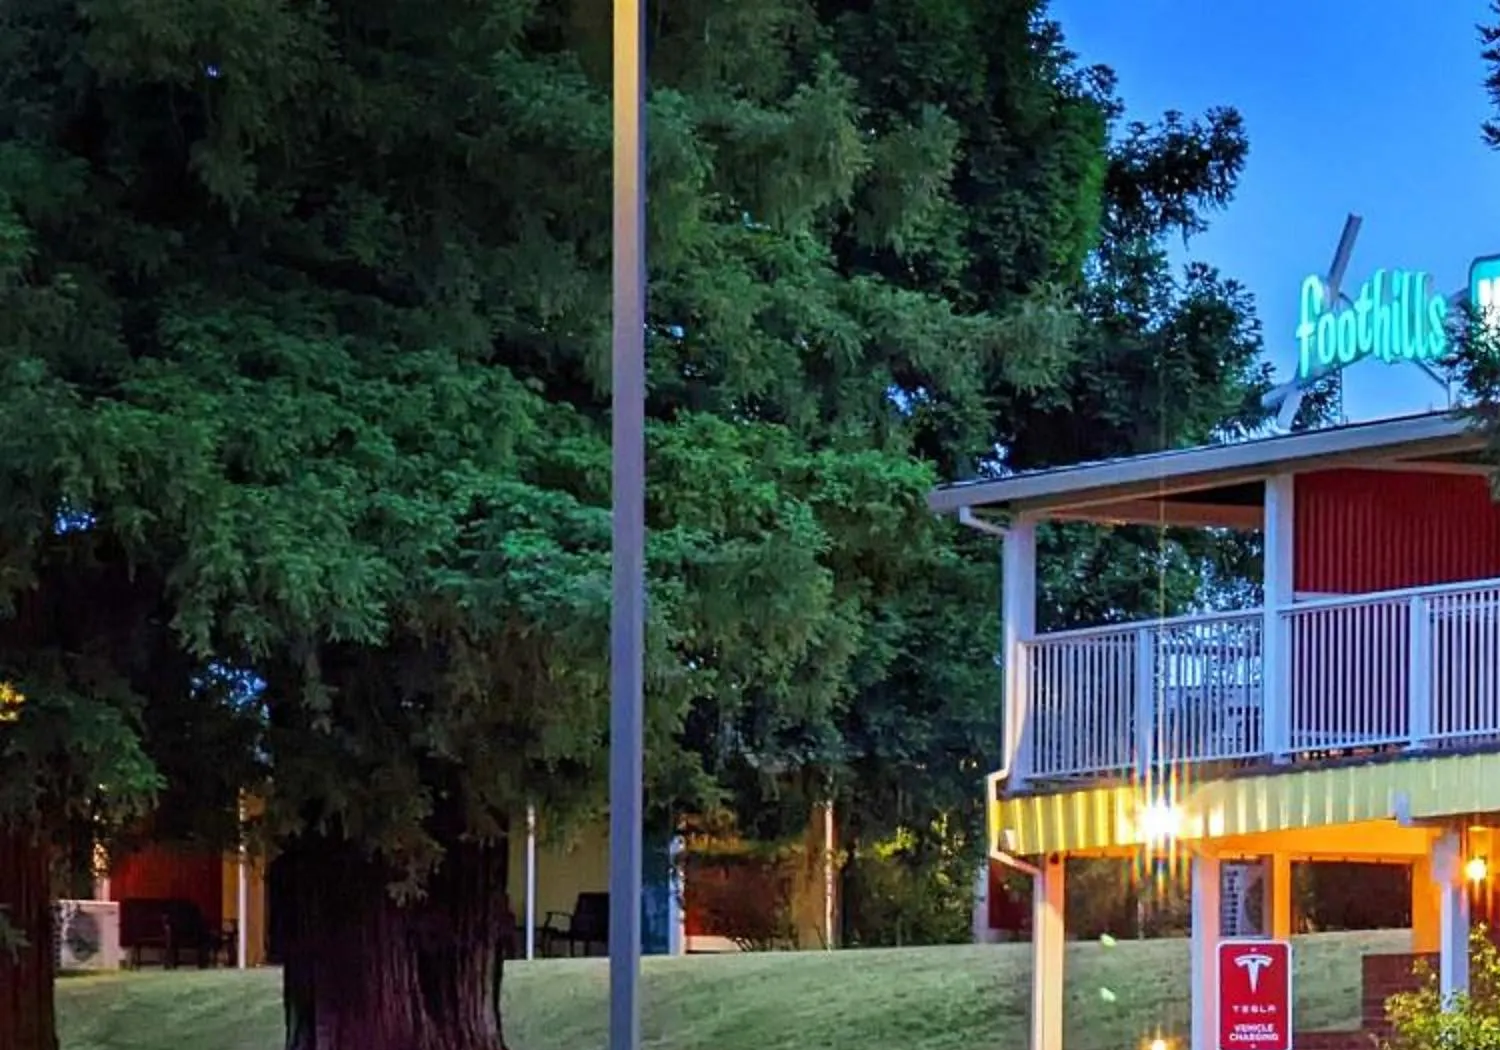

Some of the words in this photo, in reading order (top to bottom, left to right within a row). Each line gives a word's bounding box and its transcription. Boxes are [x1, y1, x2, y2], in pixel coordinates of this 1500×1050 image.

[1296, 267, 1448, 381] foothills
[1232, 1005, 1276, 1013] TESLA
[1234, 1024, 1274, 1032] VEHICLE
[1229, 1033, 1279, 1041] CHARGING
